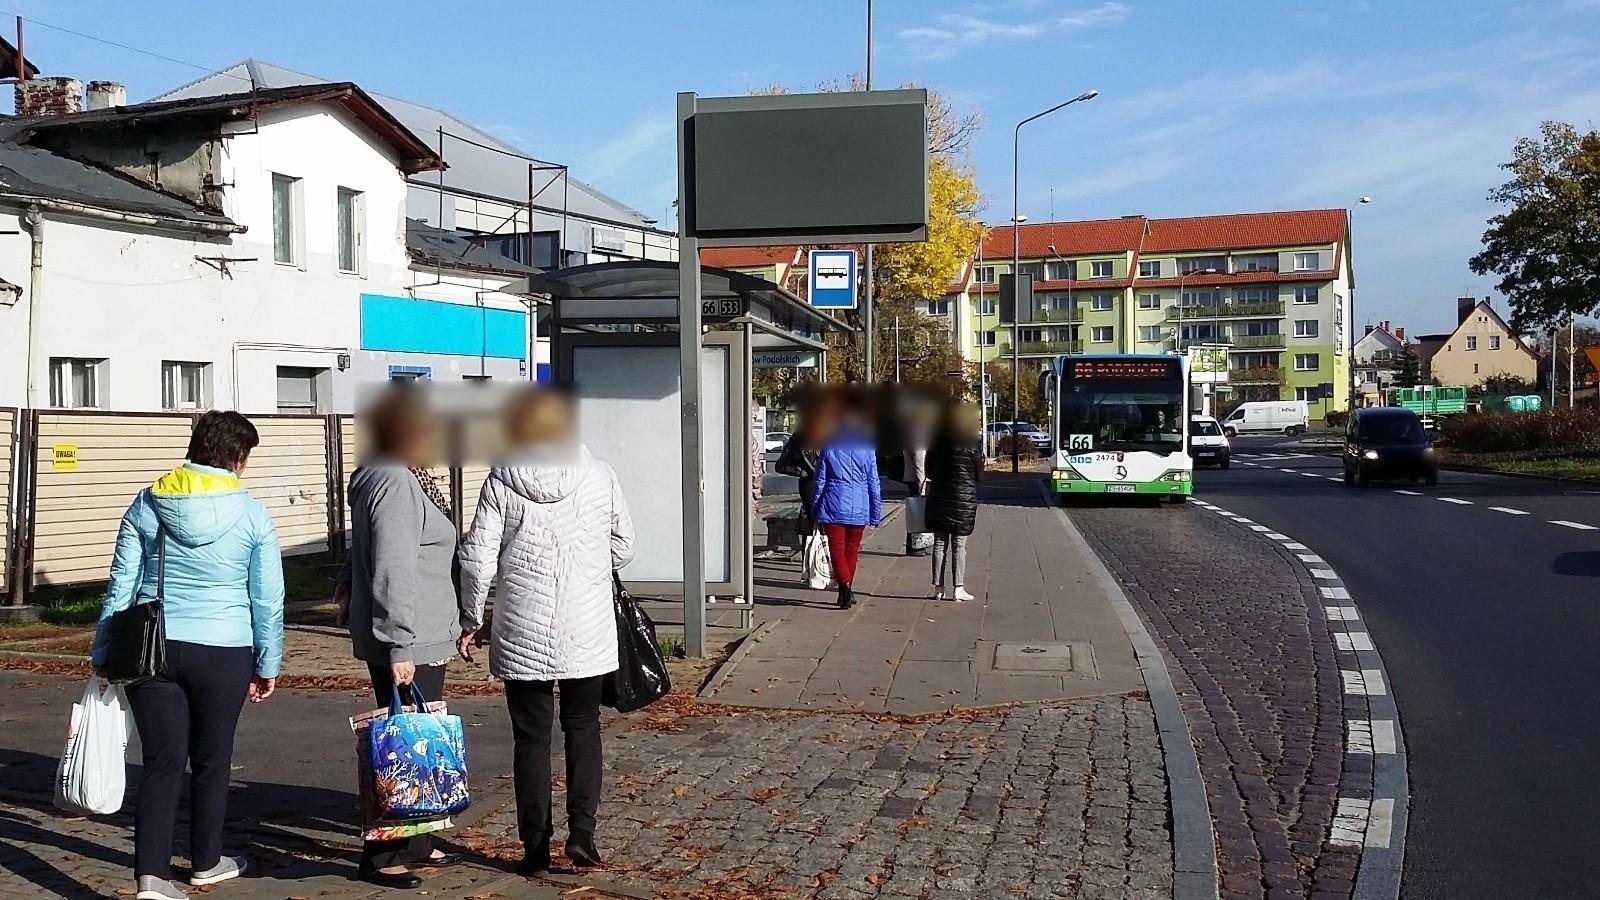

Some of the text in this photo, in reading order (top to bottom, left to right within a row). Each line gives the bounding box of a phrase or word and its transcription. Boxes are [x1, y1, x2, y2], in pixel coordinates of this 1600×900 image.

[703, 301, 739, 314] 66 533
[763, 354, 800, 364] Podolskich
[1073, 436, 1089, 449] 66
[56, 450, 75, 458] UWAGA!
